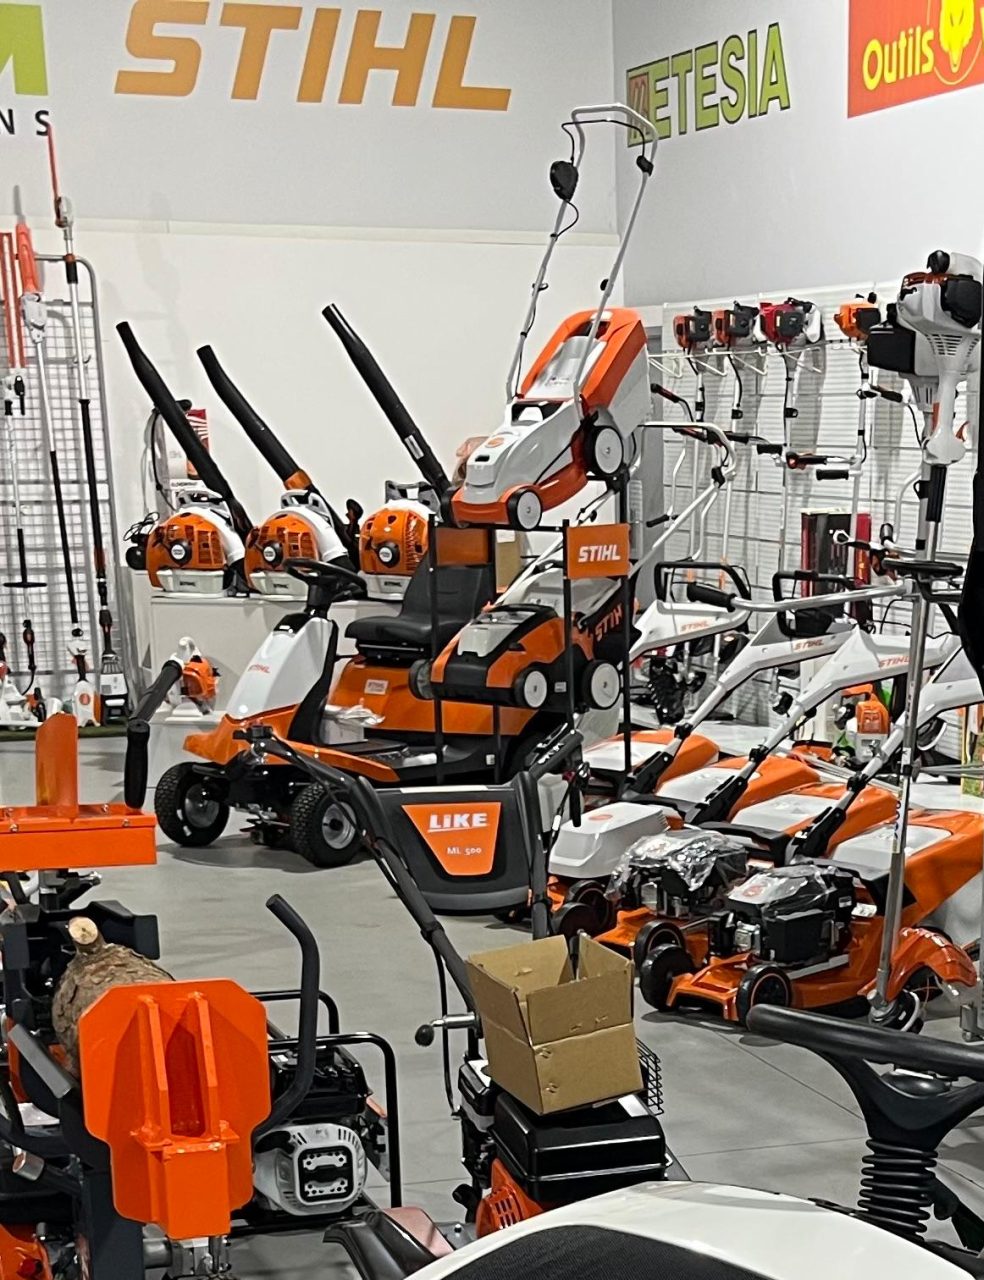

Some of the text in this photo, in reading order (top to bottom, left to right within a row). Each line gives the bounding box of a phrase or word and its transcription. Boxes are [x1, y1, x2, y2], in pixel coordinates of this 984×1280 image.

[114, 0, 511, 111] STIHL
[863, 25, 934, 91] Outils
[626, 22, 790, 148] ETESIA
[578, 545, 621, 562] STIHL
[595, 602, 623, 642] STIH
[429, 812, 488, 829] LIKE
